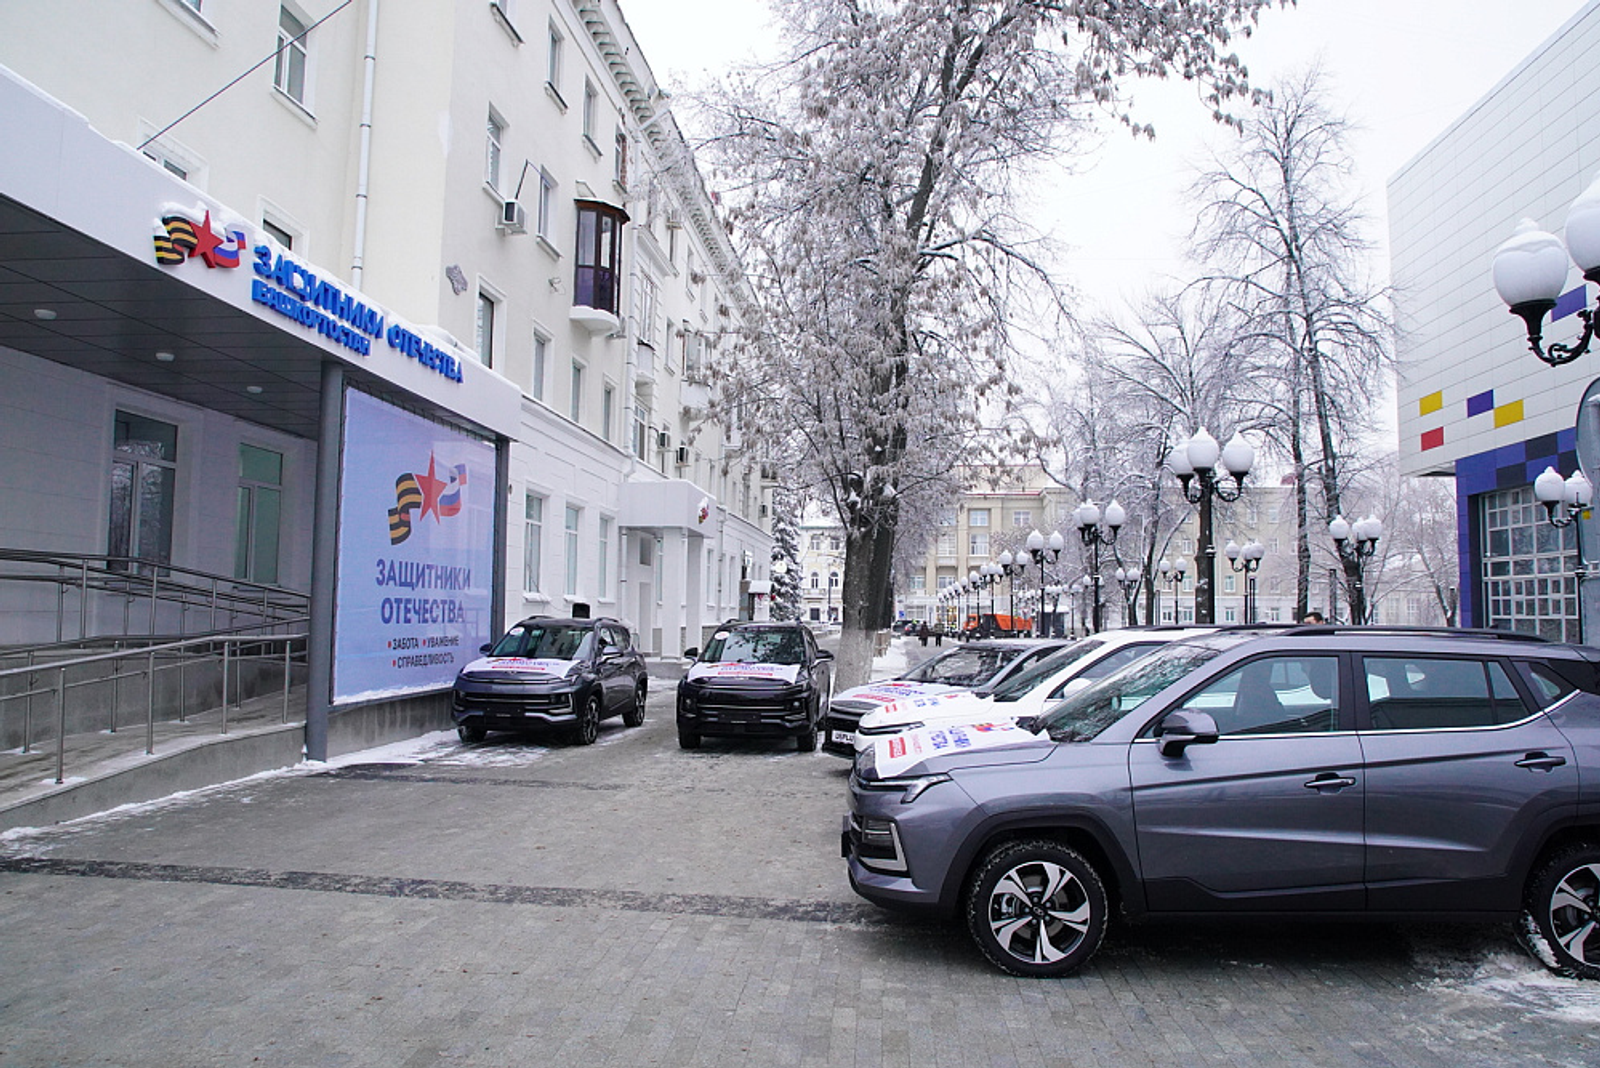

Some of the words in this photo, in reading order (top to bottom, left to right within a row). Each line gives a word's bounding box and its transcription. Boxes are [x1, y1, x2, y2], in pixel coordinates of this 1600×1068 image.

[252, 279, 371, 356] БАШКОРТОСТАН
[253, 245, 384, 338] ЗАЩИТНИКИ
[387, 324, 463, 383] ОТЕЧЕСТВА
[375, 558, 471, 591] ЗАЩИТНИКИ
[380, 597, 465, 624] ОТЕЧЕСТВА
[392, 637, 419, 650] ЗАБОТА
[427, 635, 459, 648] УВАЖЕНИЕ
[397, 652, 454, 669] СПРАВЕДЛИВОСТЬ
